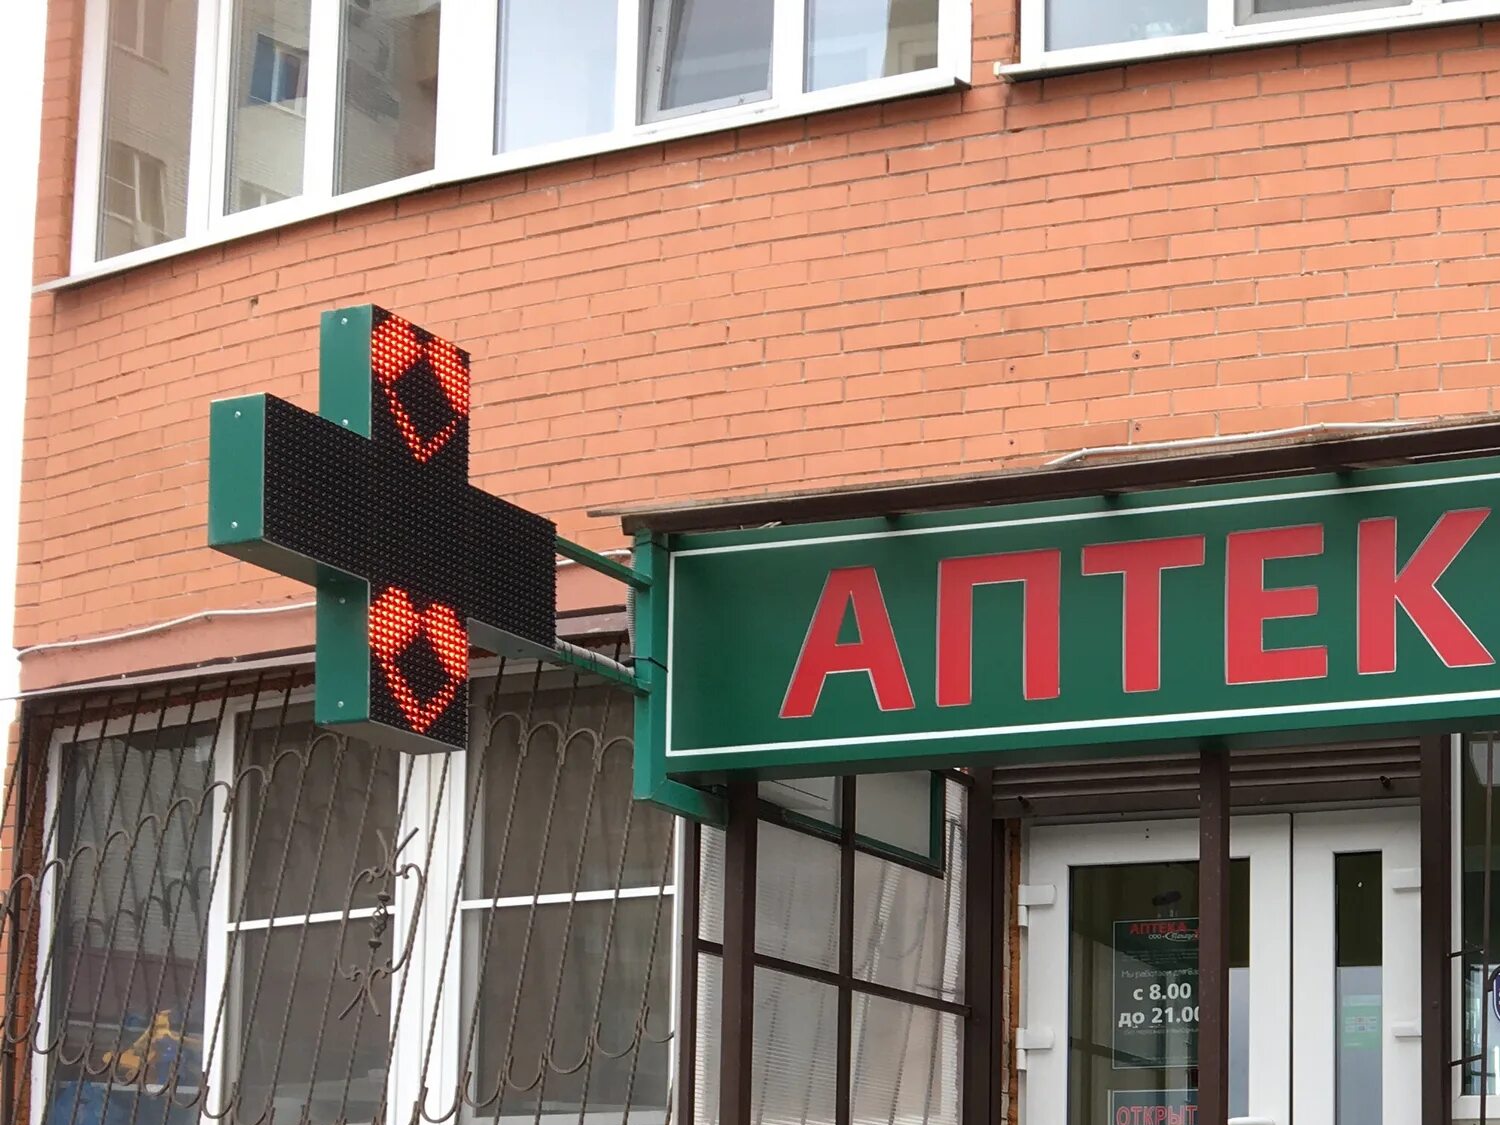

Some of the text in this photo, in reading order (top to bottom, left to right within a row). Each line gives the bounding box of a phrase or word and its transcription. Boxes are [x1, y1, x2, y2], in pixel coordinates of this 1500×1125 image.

[1129, 922, 1188, 934] АПТЕКА
[1133, 983, 1192, 1000] с 8.00
[1118, 1012, 1145, 1028] до
